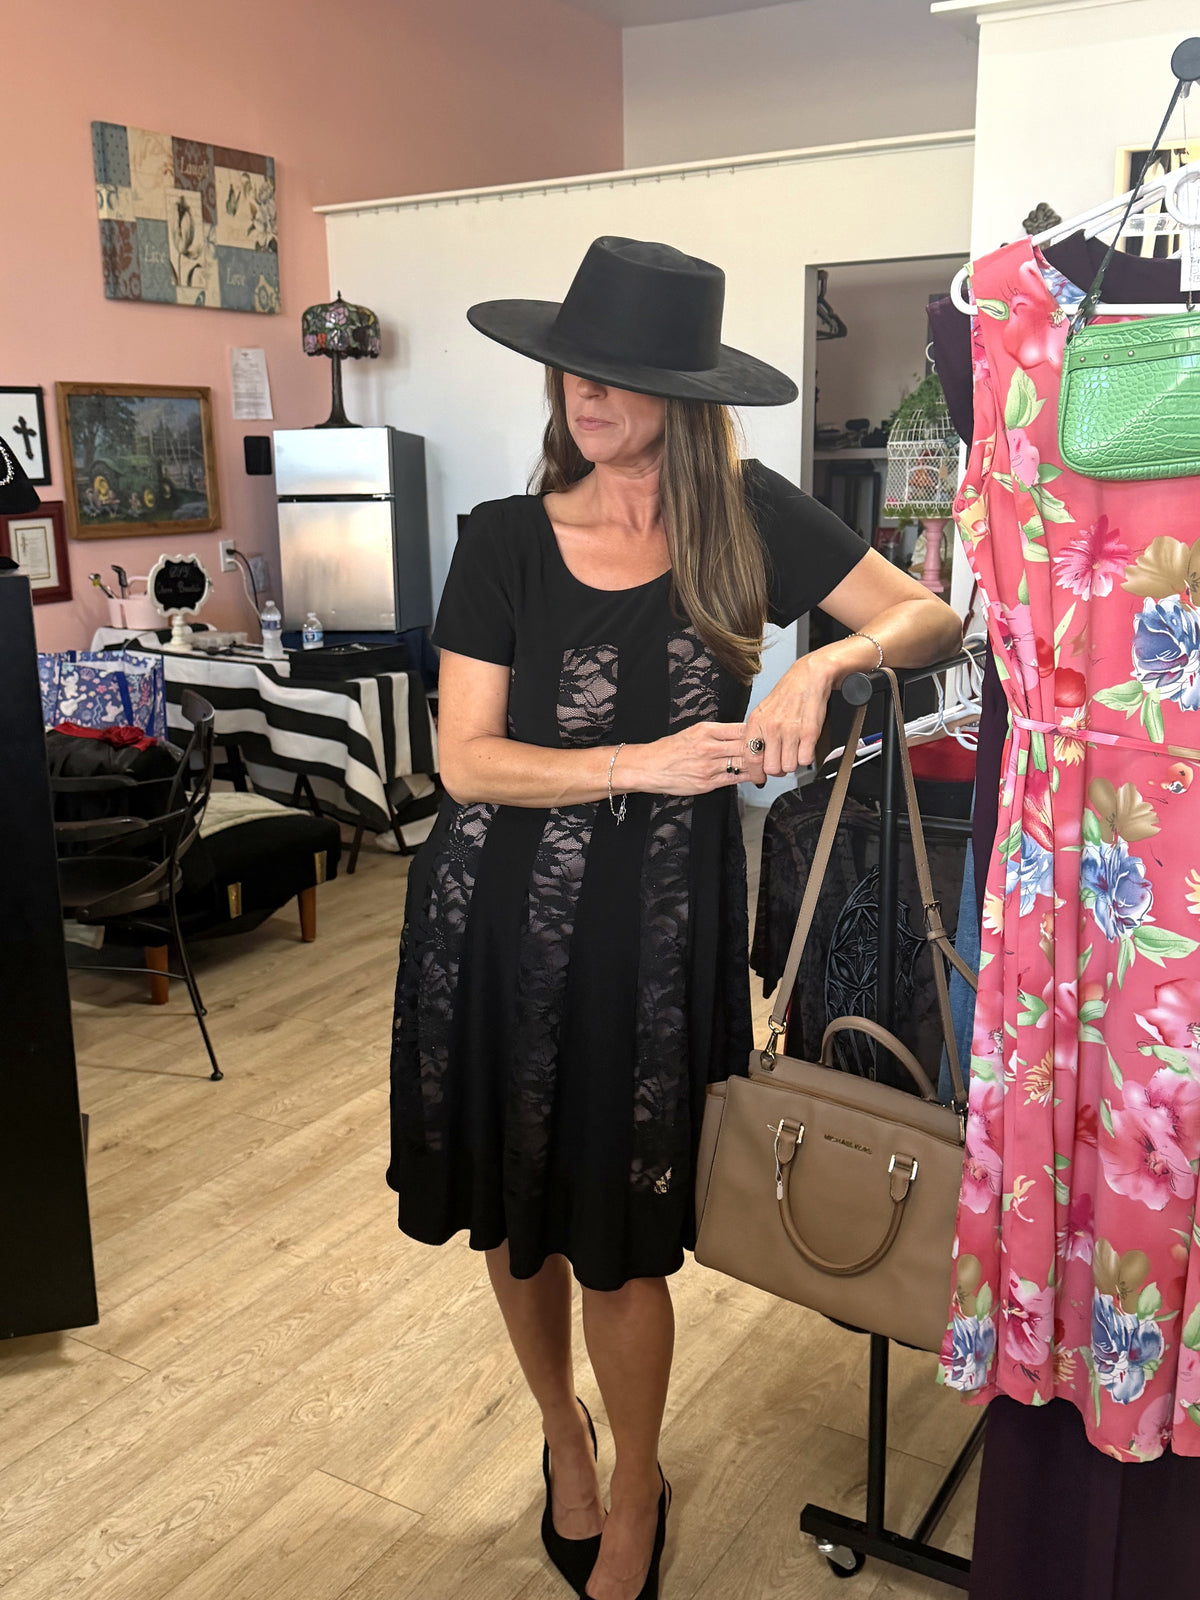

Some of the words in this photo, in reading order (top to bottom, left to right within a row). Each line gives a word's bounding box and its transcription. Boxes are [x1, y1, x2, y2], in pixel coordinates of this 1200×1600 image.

[180, 156, 209, 180] Laugh
[823, 1133, 854, 1149] MICHAEL
[854, 1143, 873, 1155] KORS
